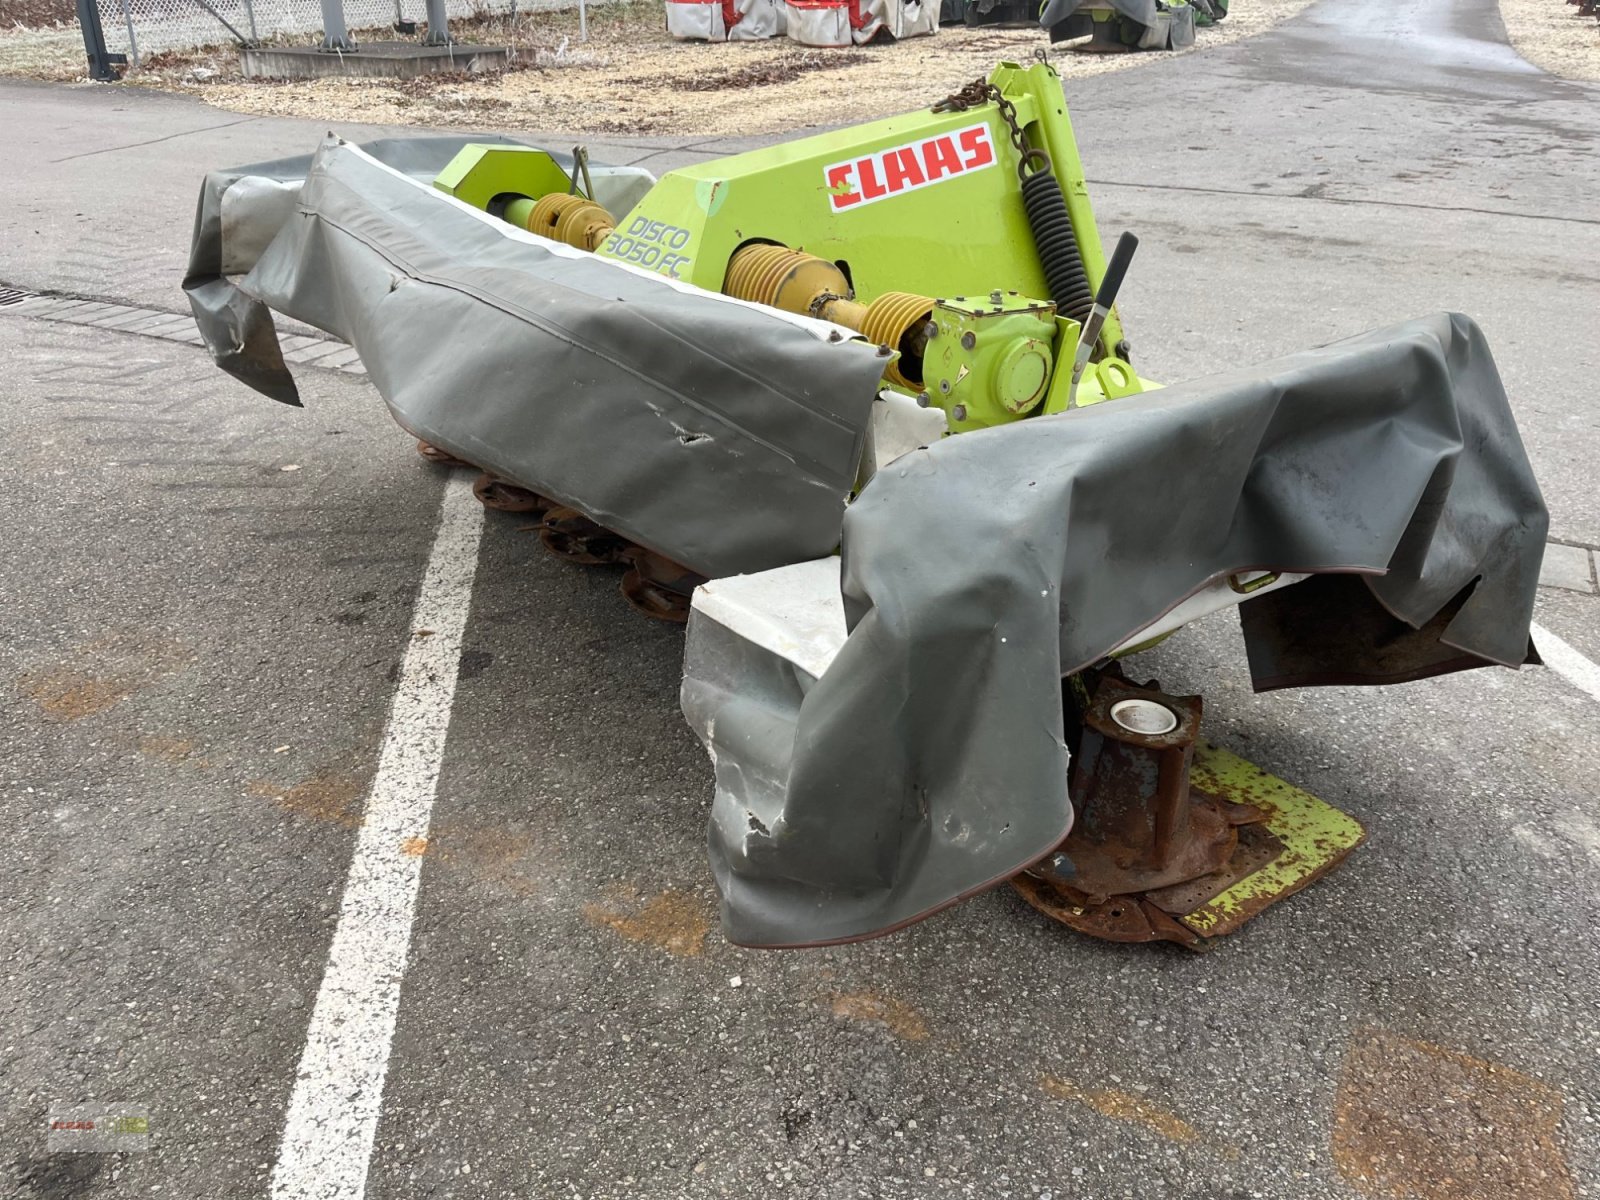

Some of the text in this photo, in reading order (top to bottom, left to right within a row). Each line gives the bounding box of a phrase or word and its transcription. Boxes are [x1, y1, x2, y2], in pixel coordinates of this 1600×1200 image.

[828, 127, 992, 208] CLAAS
[627, 216, 690, 249] DISCO
[606, 233, 691, 278] 3050 FC
